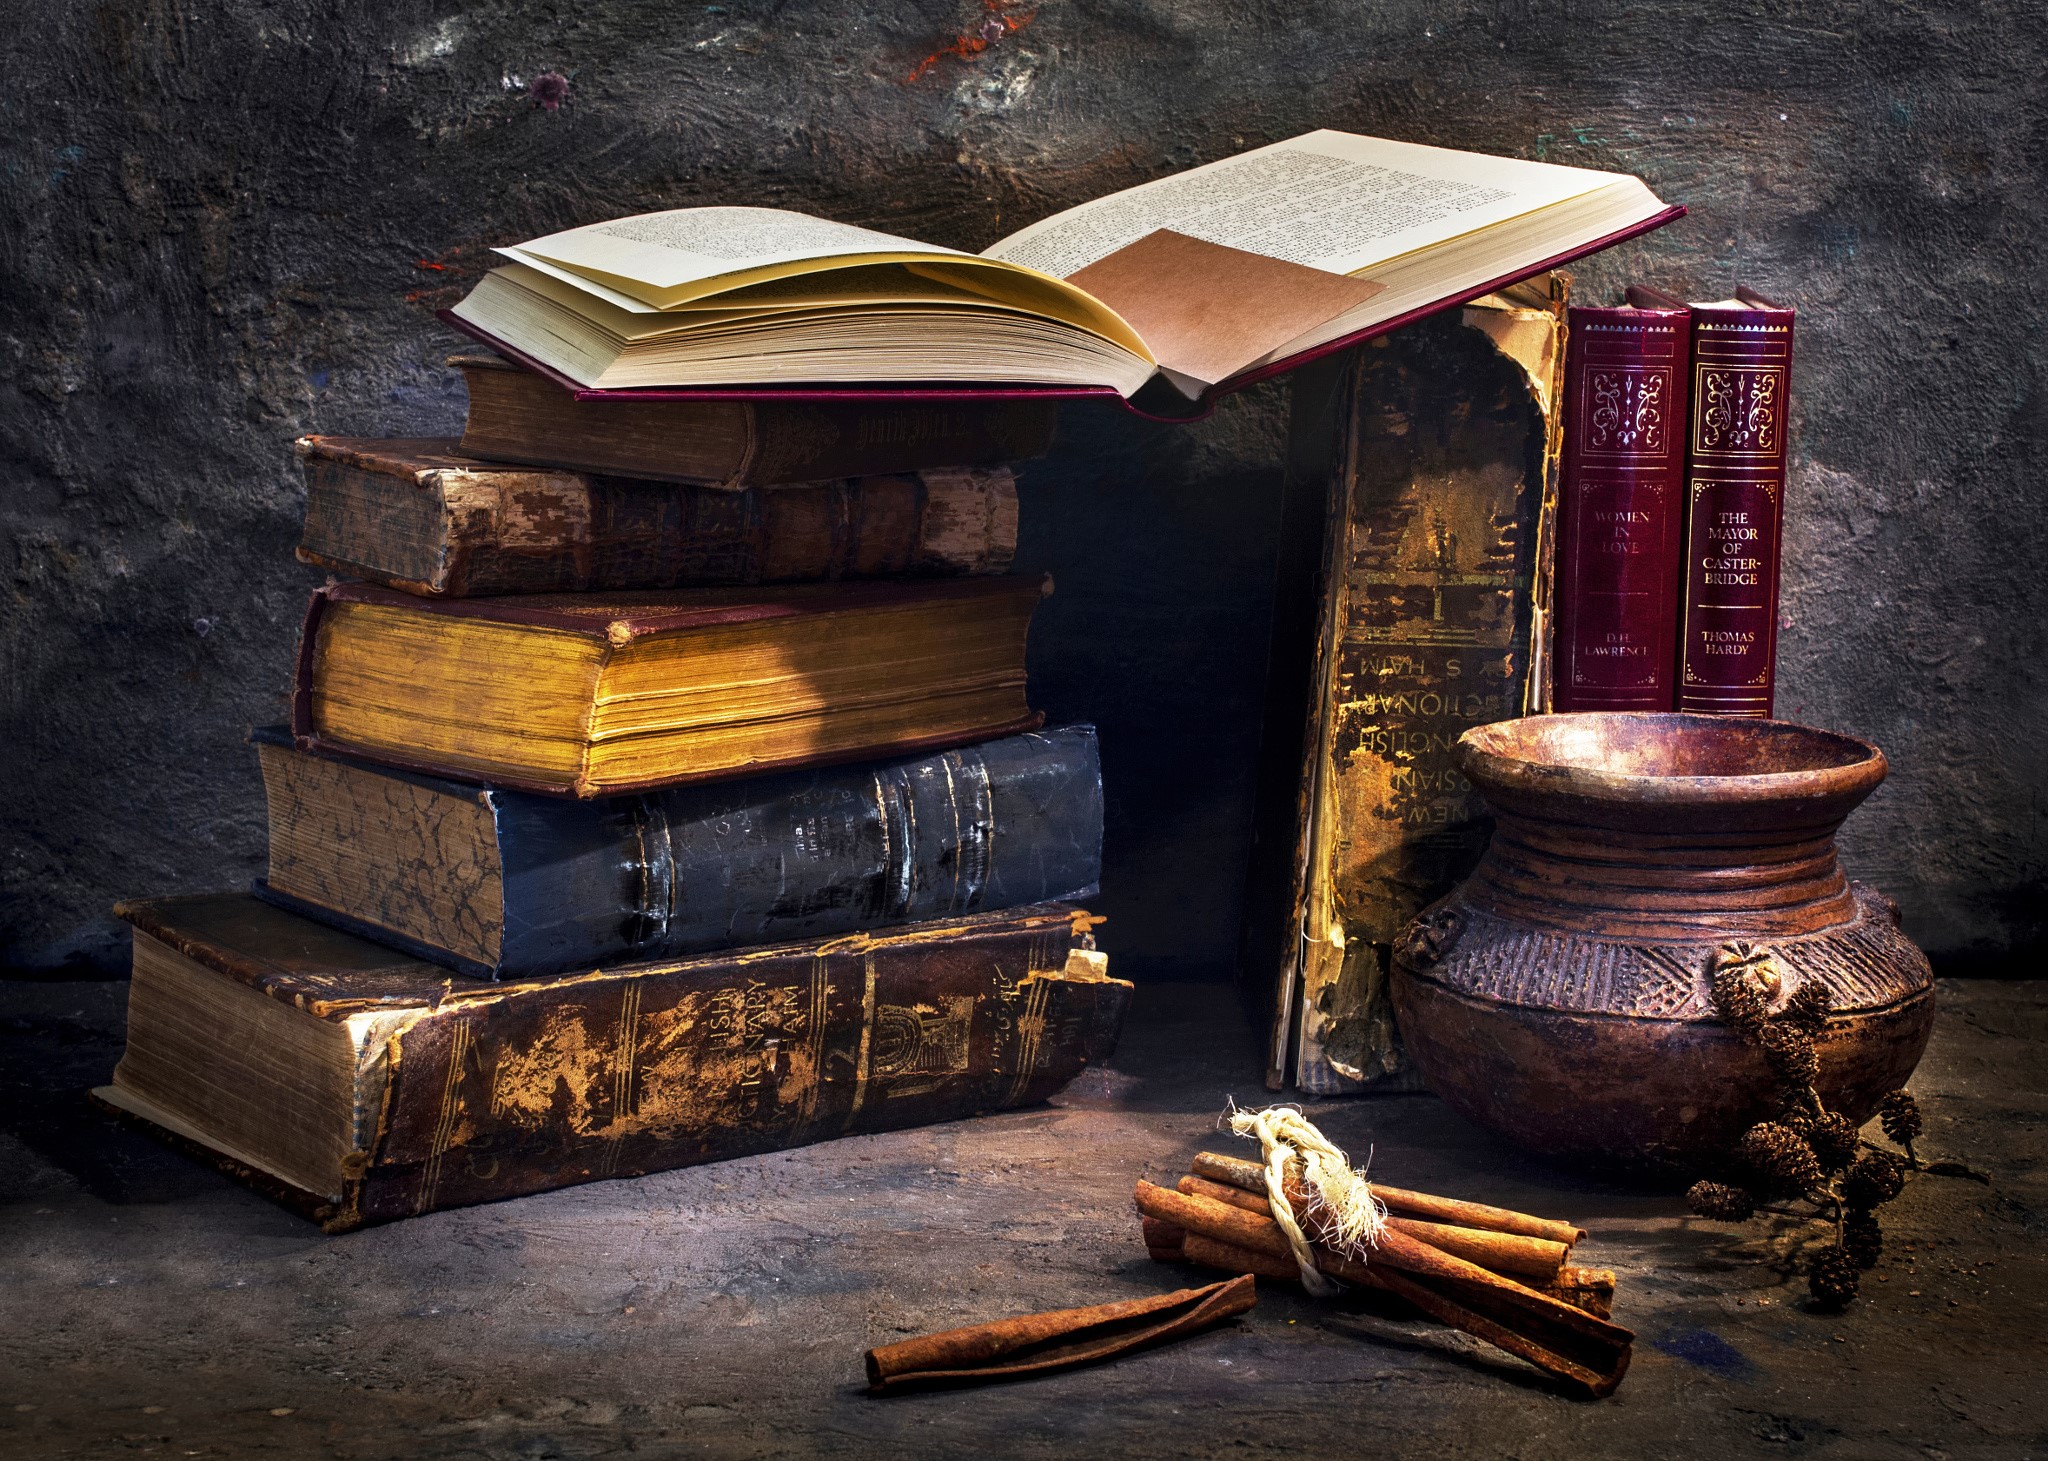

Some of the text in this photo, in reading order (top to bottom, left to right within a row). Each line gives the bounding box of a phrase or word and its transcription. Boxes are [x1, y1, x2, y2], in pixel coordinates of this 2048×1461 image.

[1595, 511, 1650, 523] WOMEN
[1718, 512, 1749, 524] THE
[1614, 526, 1630, 538] IN
[1708, 527, 1759, 540] MAYOR
[1602, 542, 1640, 554] LOVE
[1722, 543, 1743, 554] OF
[1702, 557, 1762, 570] CASTER-
[1705, 573, 1758, 585] BRIDGE
[1701, 631, 1755, 642] THOMAS
[1585, 645, 1648, 657] LAWRENCE
[1705, 644, 1749, 655] HARDY
[1446, 658, 1462, 676] S
[1358, 731, 1460, 754] NGLISH
[1408, 806, 1469, 823] NEW
